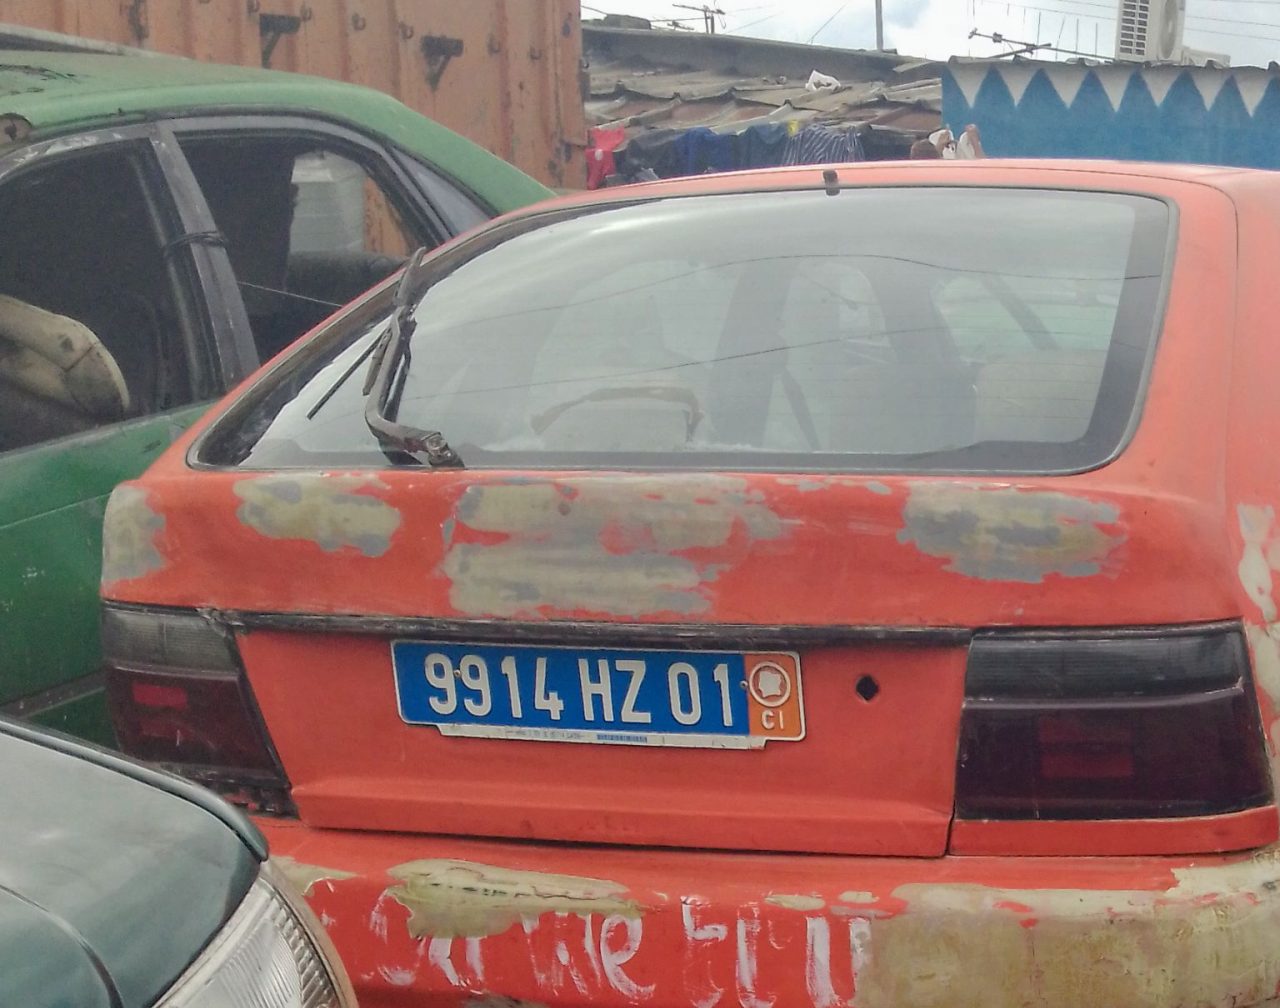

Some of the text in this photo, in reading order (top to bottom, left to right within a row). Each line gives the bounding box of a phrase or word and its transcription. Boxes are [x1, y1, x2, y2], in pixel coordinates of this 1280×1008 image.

[424, 652, 734, 727] 9914 HZ 01
[761, 708, 785, 730] CI
